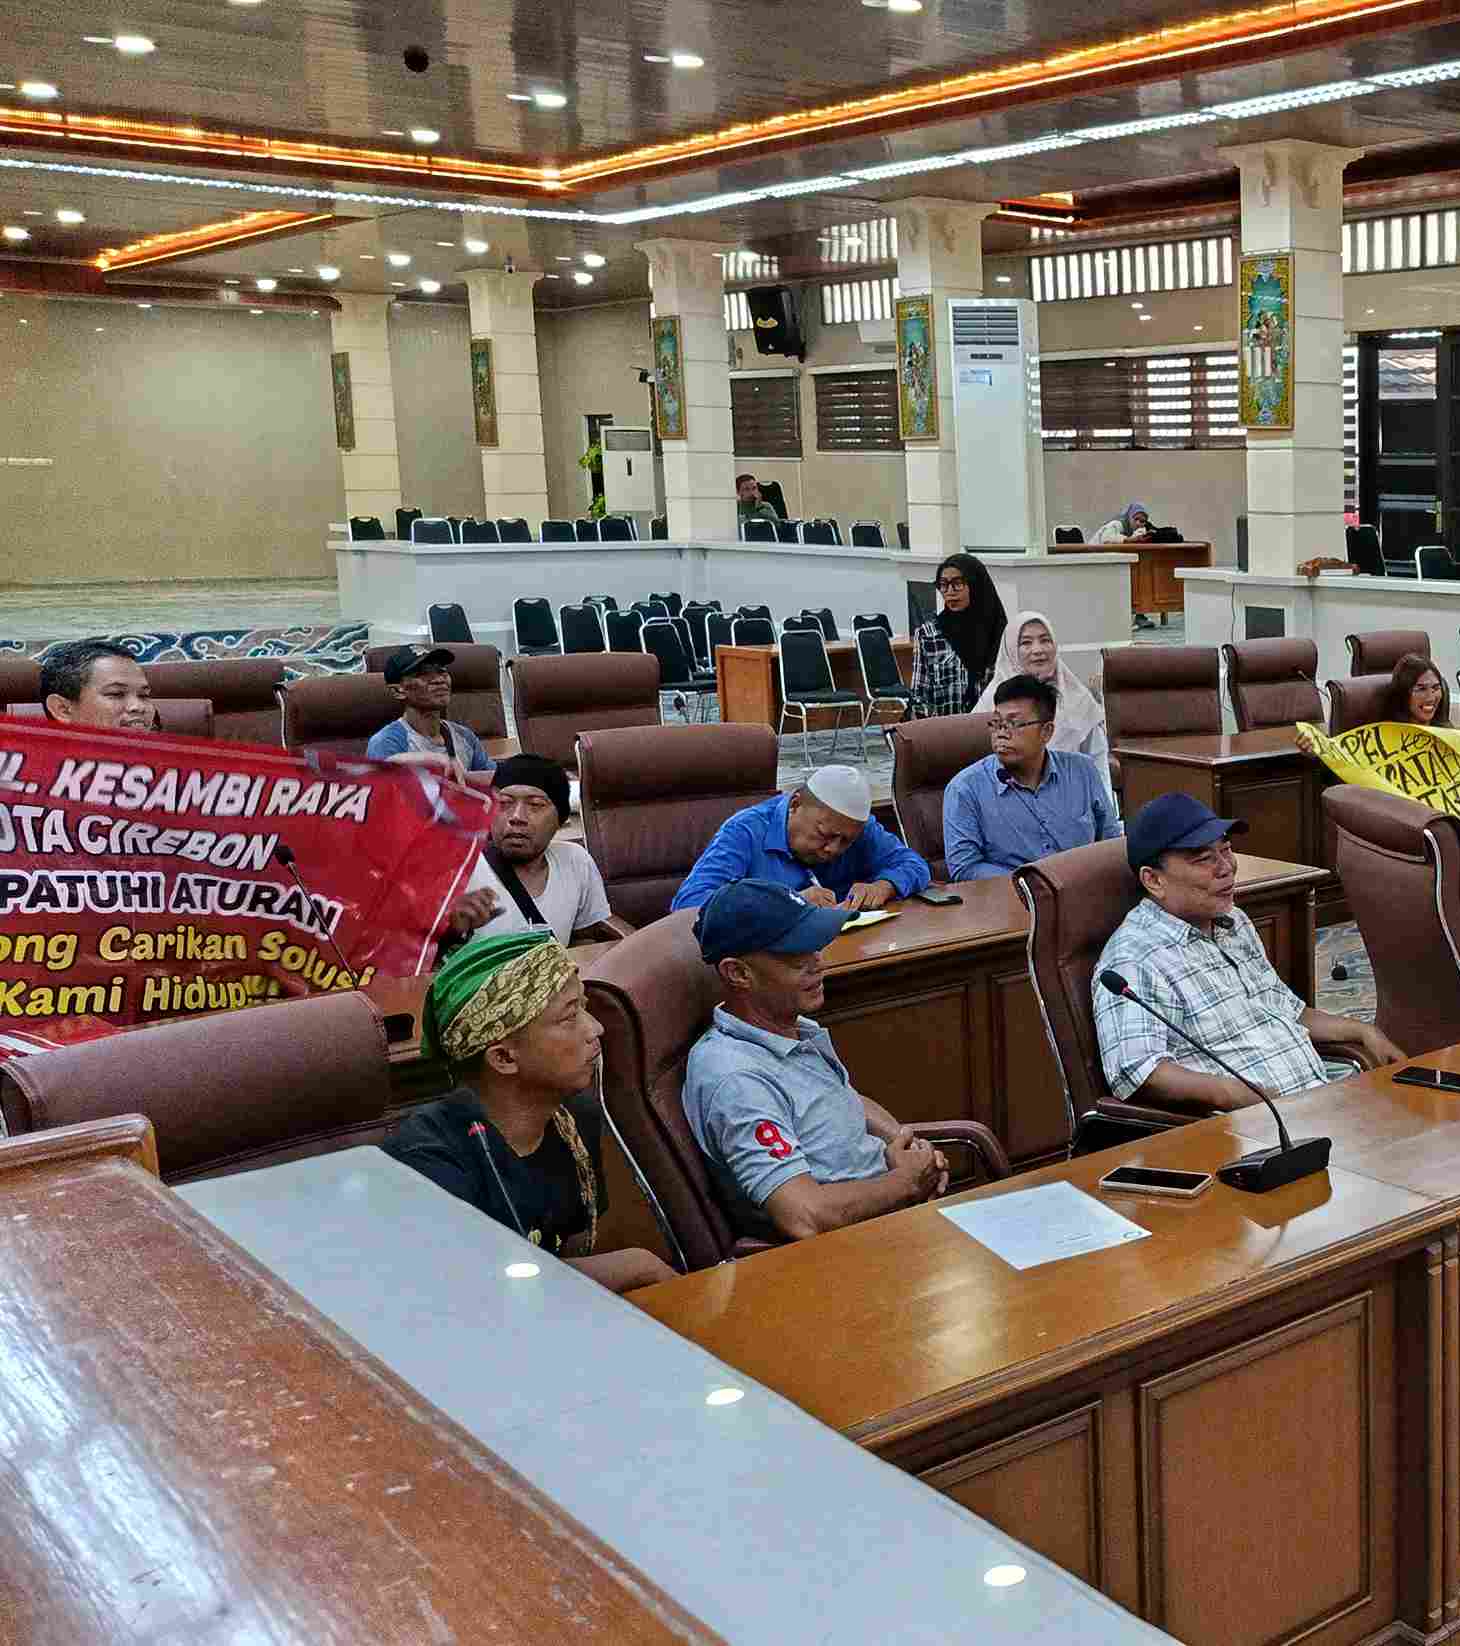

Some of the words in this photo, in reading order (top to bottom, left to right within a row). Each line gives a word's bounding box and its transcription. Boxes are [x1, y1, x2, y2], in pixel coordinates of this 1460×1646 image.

[0, 752, 38, 794] L.
[49, 757, 267, 818] KESAMBI
[263, 776, 373, 823] RAYA
[0, 802, 74, 854] OTA
[77, 813, 279, 871] CIREBON
[0, 870, 165, 913] PATUHI
[171, 874, 344, 940] ATURAN
[98, 924, 249, 963] Carikan
[0, 975, 125, 1017] Kami
[755, 1119, 793, 1161] 9
